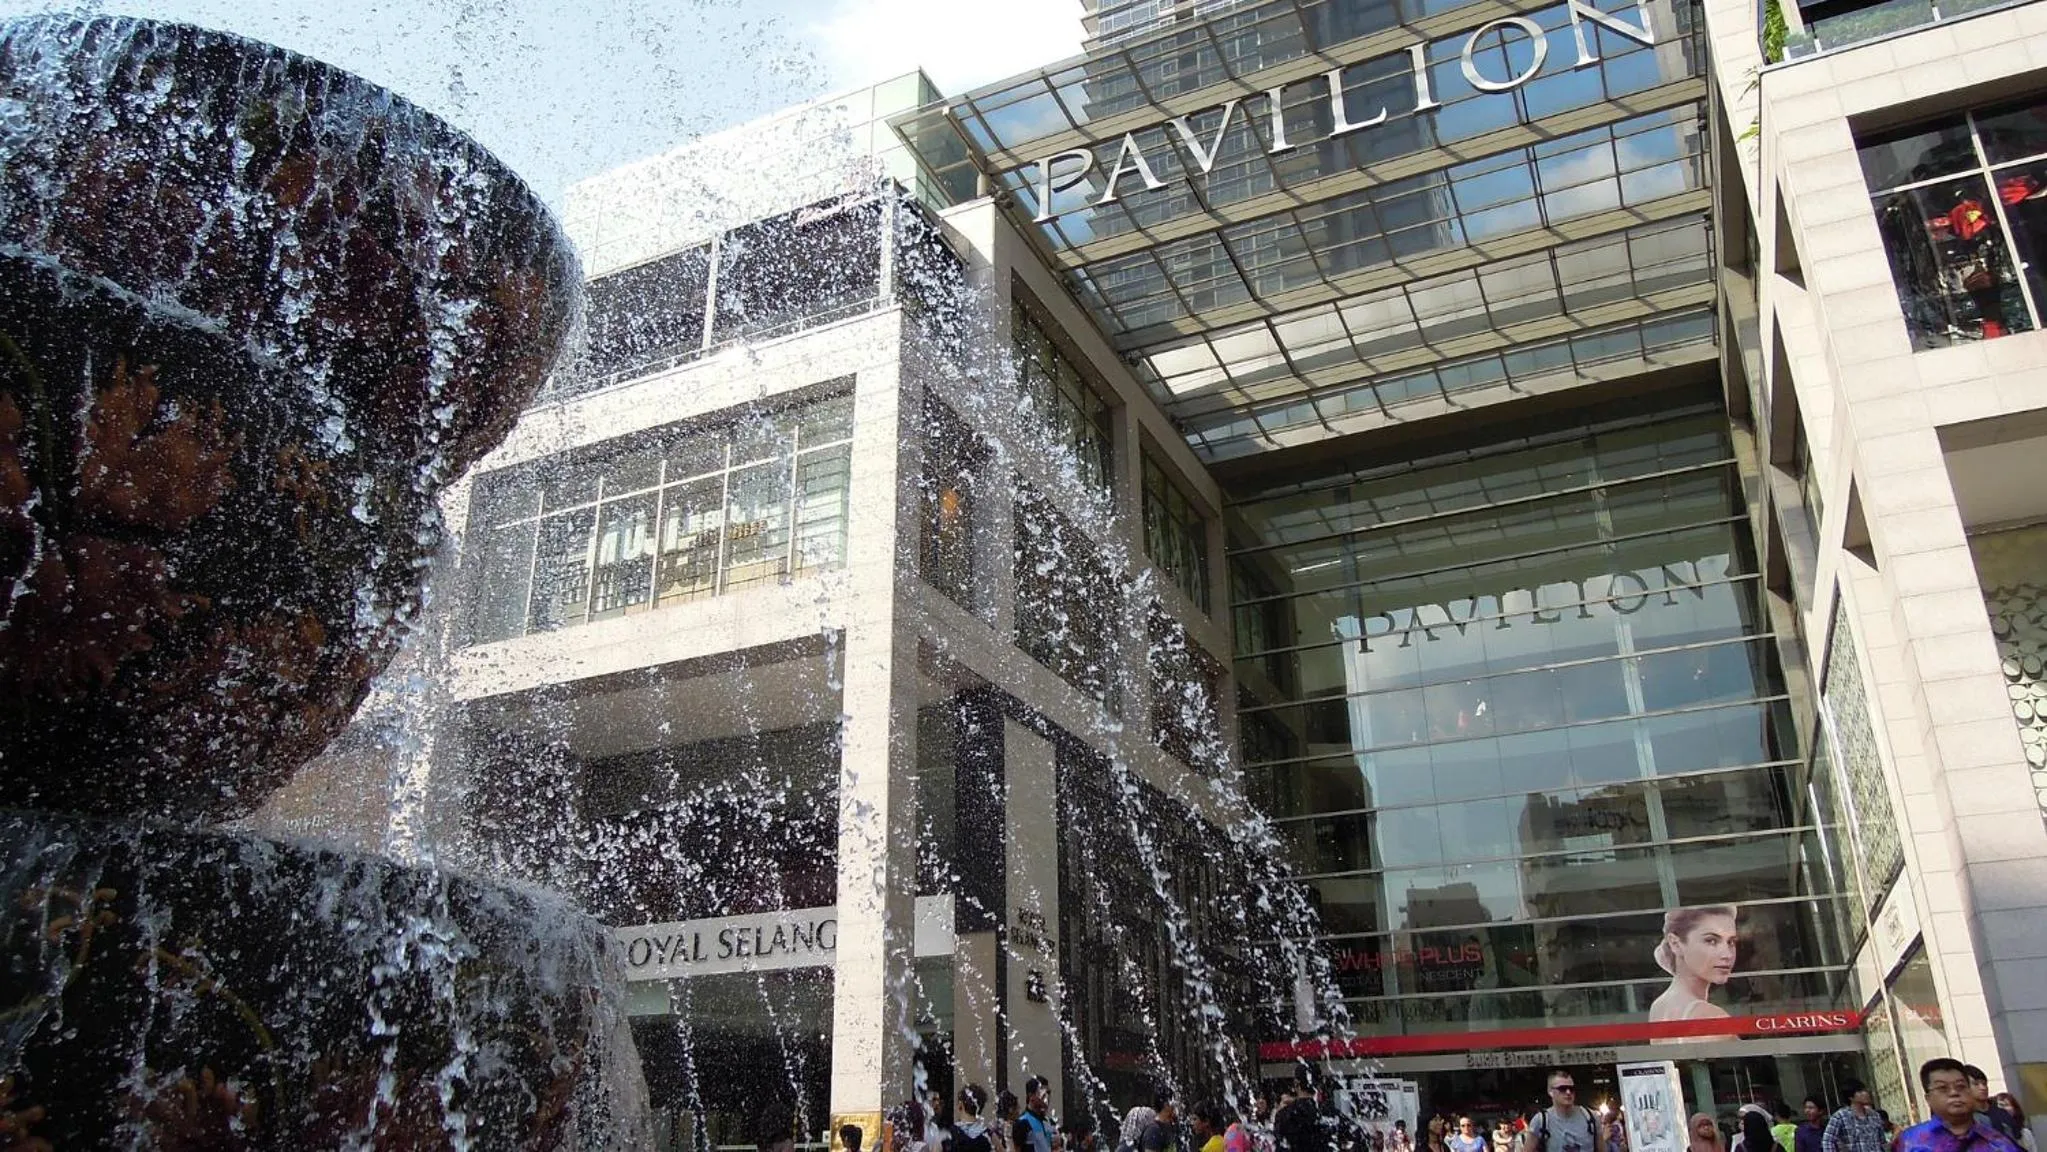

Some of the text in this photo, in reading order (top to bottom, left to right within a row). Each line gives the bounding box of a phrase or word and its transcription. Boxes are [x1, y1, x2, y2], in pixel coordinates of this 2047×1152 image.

[1033, 0, 1655, 223] PAVILION
[1357, 561, 1707, 654] PAVILION
[1418, 944, 1481, 966] PLUS
[1755, 1014, 1847, 1030] CLARINS
